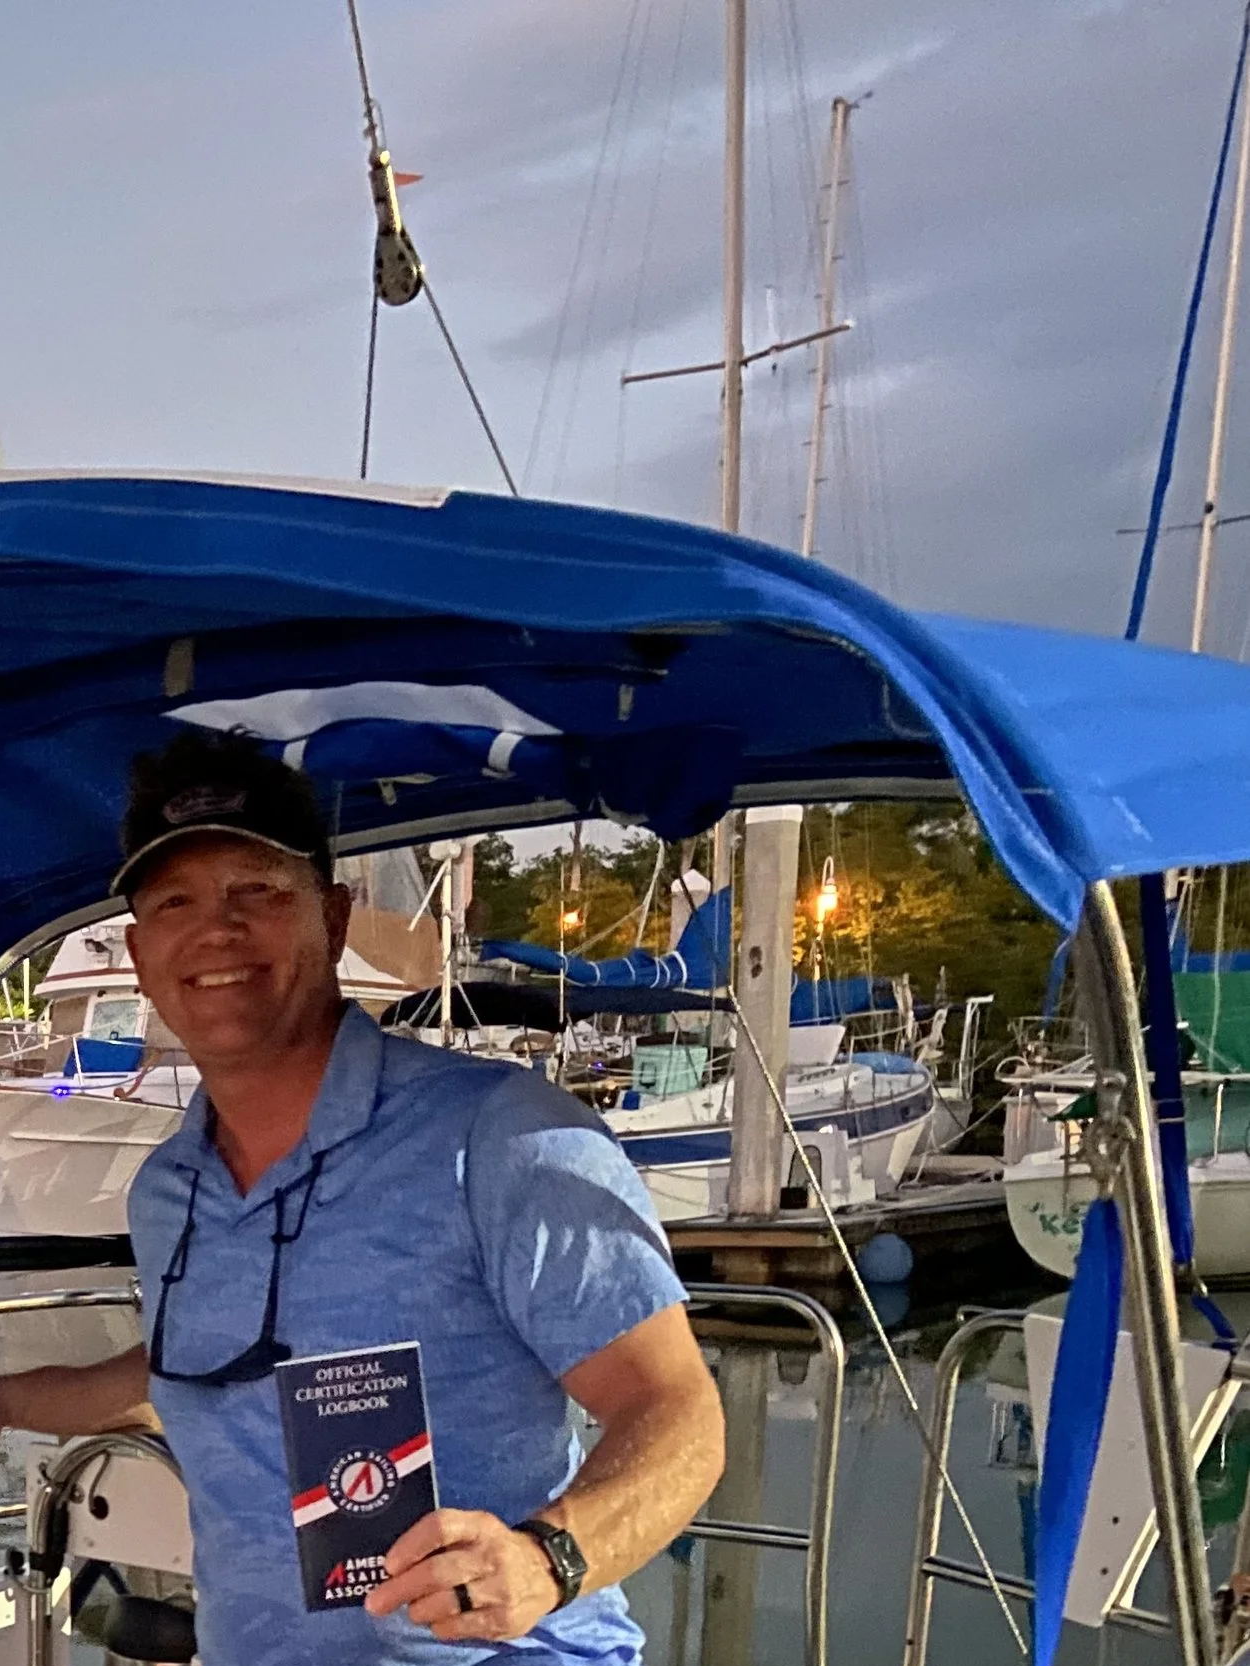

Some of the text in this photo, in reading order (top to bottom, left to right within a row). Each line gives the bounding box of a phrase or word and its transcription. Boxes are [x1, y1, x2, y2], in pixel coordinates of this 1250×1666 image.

[315, 1361, 385, 1382] OFFICIAL
[295, 1375, 408, 1401] CERTIFICATION
[317, 1395, 389, 1416] LOGBOOK
[345, 1555, 387, 1571] AMER
[347, 1569, 390, 1583] SAIL
